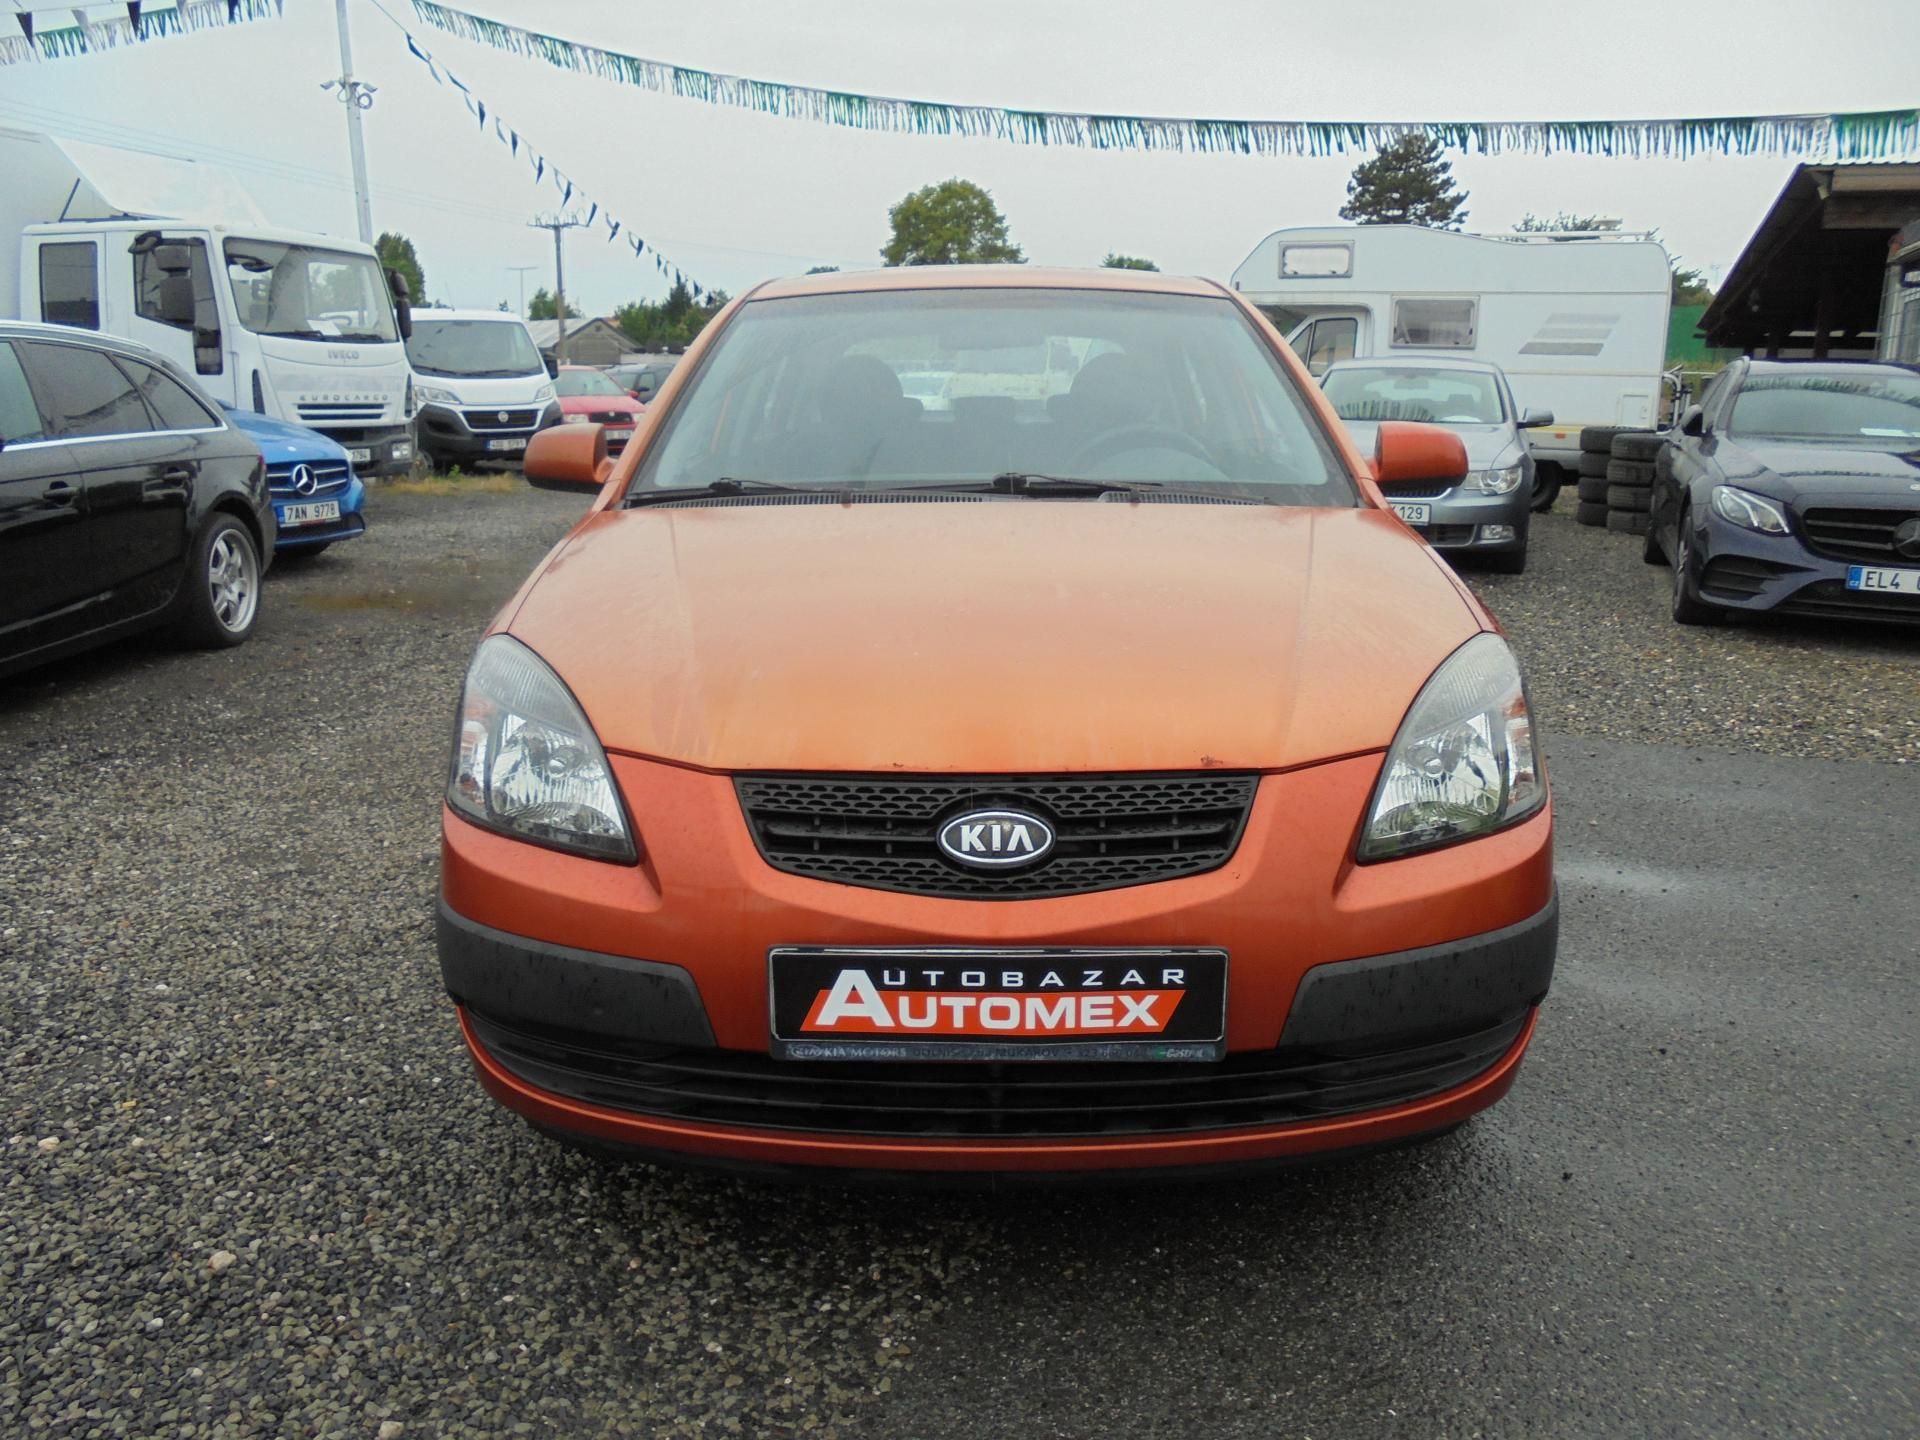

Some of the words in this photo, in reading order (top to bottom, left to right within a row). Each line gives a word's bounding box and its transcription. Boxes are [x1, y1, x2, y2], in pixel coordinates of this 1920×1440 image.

[328, 350, 359, 360] IVECO
[287, 505, 308, 521] 7AN
[1864, 570, 1901, 590] EL4
[960, 824, 1034, 852] KIA
[815, 968, 1160, 1029] AUTOMEX
